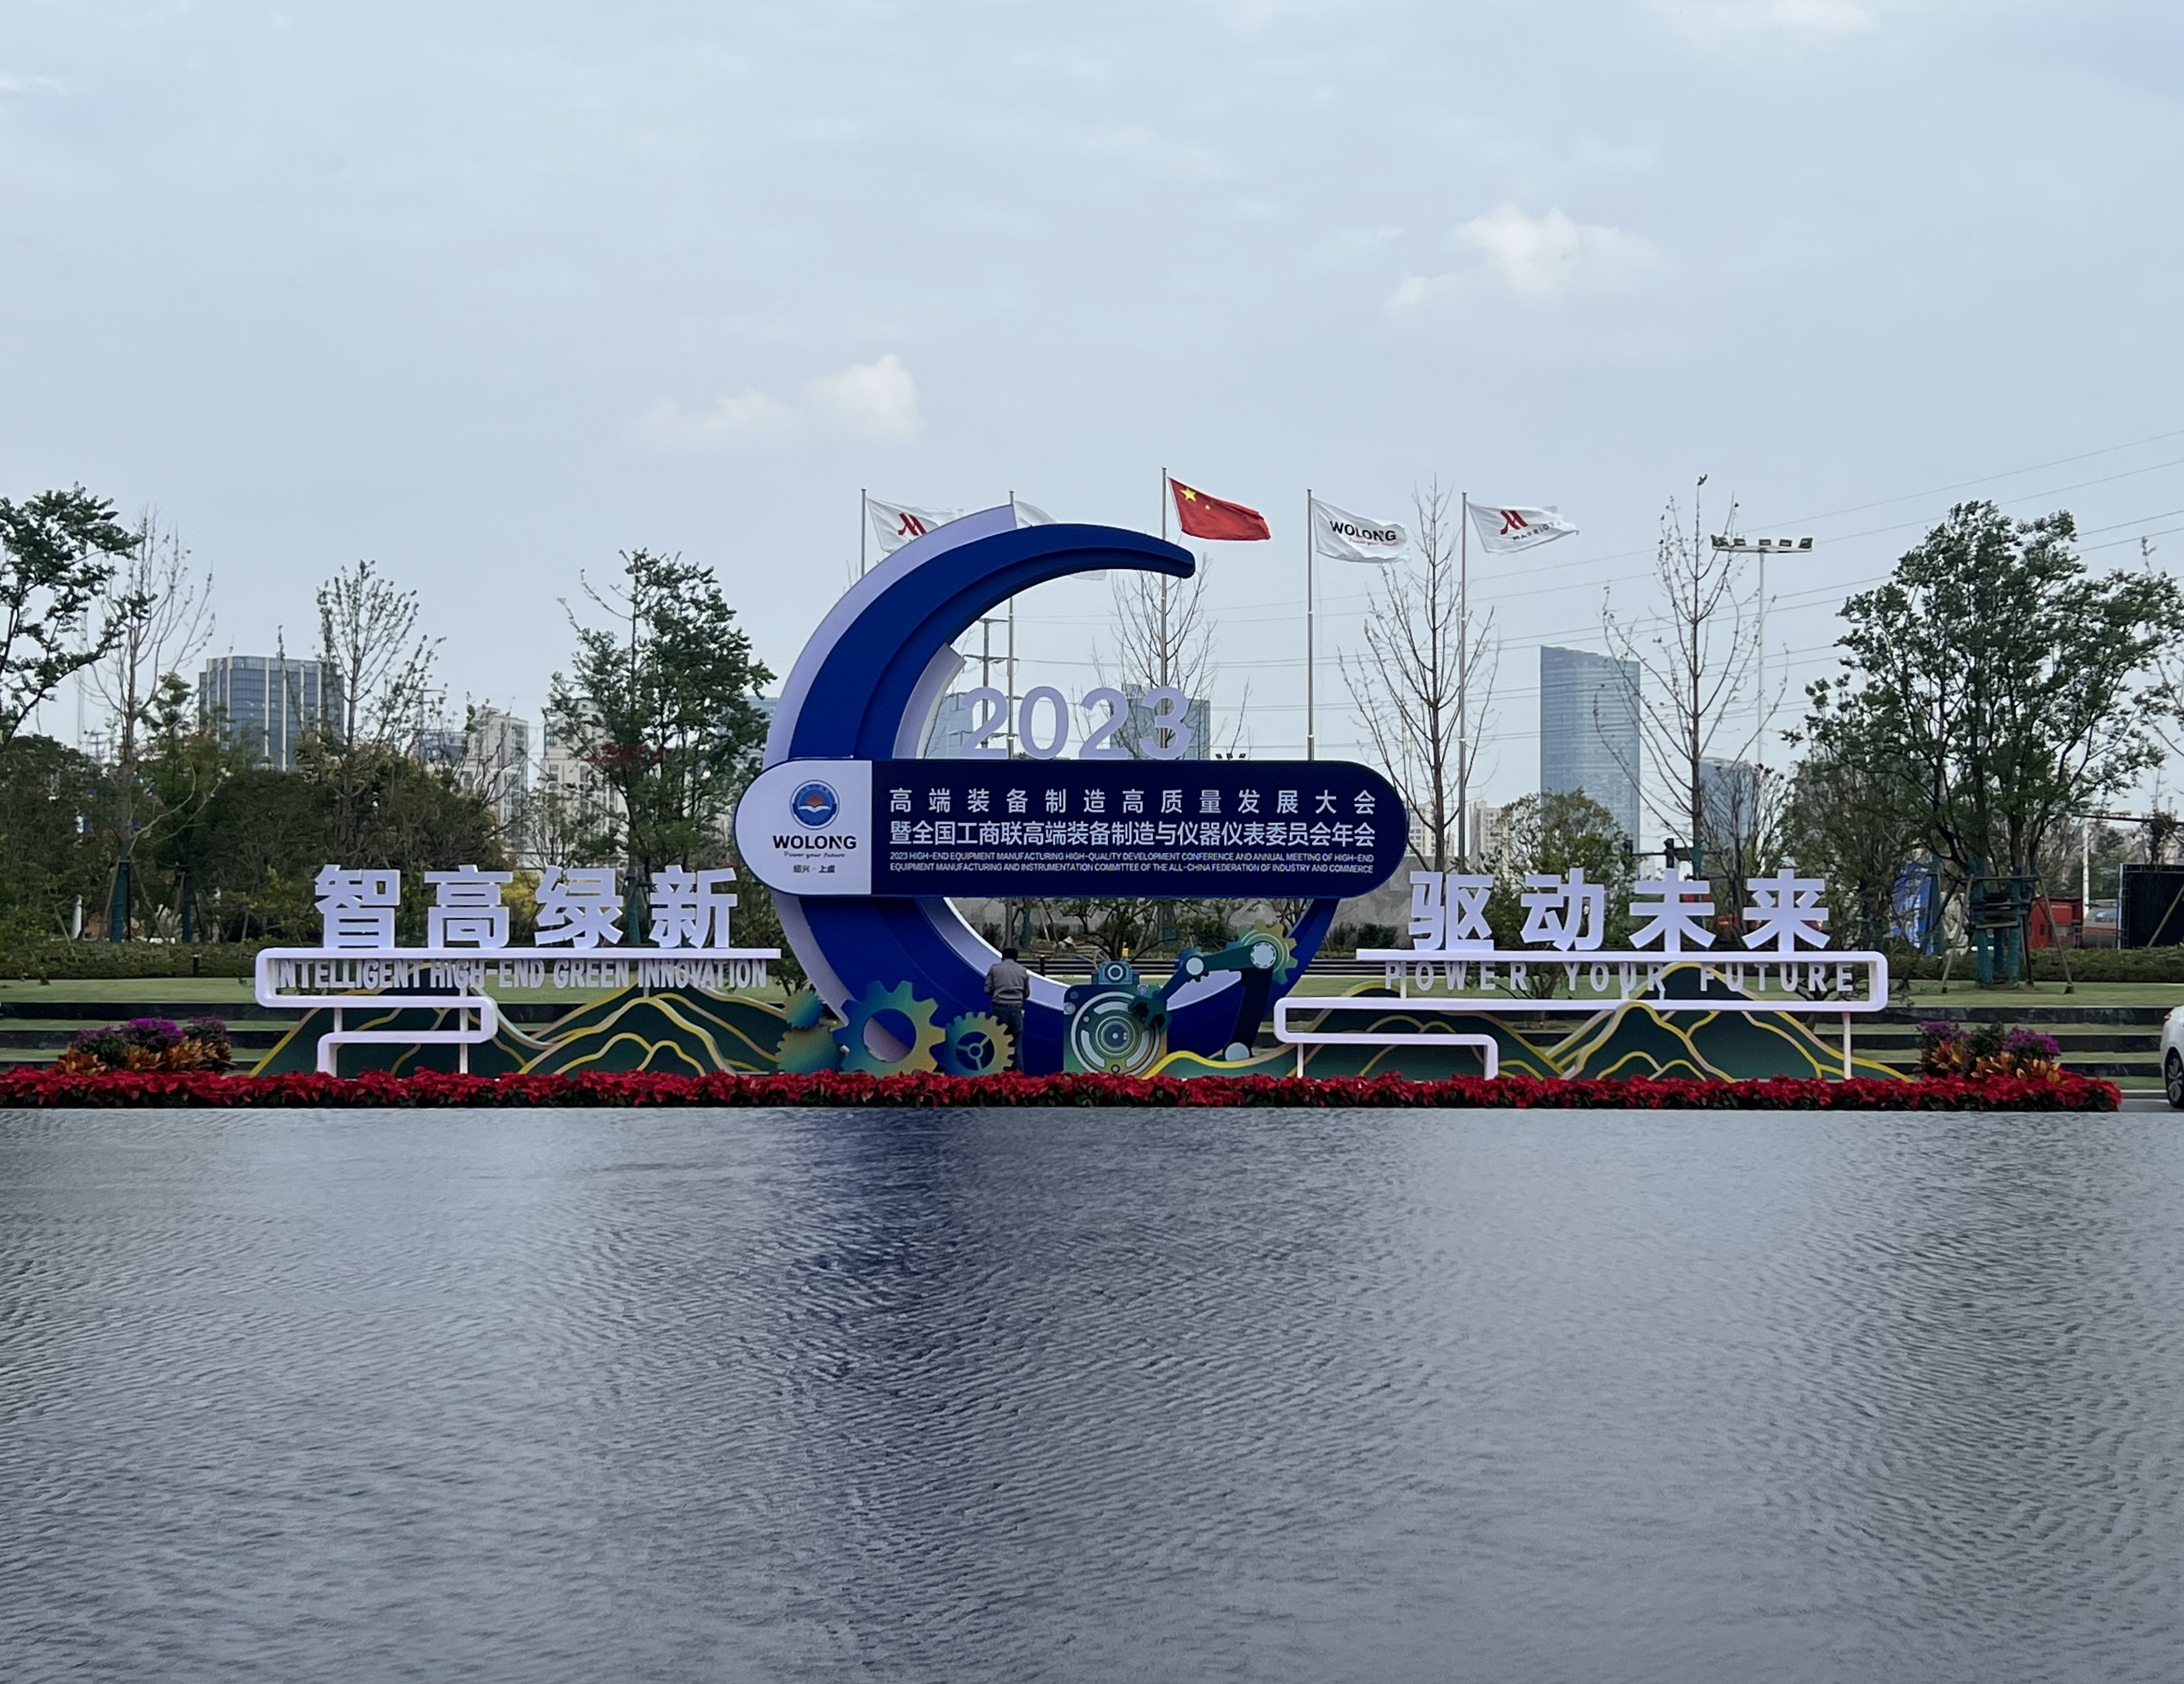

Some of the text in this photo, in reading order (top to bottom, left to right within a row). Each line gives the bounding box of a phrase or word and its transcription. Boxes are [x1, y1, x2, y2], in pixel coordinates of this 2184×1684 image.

[1329, 521, 1396, 542] WOLONG
[960, 686, 1191, 760] 2023
[890, 788, 1375, 814] 高端装备制造高质量发展大会
[773, 835, 857, 849] WOLONG
[890, 821, 1375, 847] 暨全国工商联高端装备制造与仪器仪表委员会年会
[891, 863, 934, 872] EQUIPMENT
[936, 863, 1002, 871] MANUFACTURING
[1212, 863, 1259, 872] FEDERATION
[1329, 865, 1373, 873] COMMERCE
[909, 852, 949, 860] HIGH-END
[950, 852, 995, 861] EQUIPMENT
[997, 852, 1063, 860] MANUFACTURING
[1066, 852, 1121, 861] HIGH-QUALITY
[1123, 852, 1180, 860] DEVELOPMENT
[1182, 852, 1233, 860] CONFERENCE
[1335, 854, 1373, 862] HIGH-END
[315, 864, 737, 948] 智高绿新
[1408, 868, 1830, 952] 驱动未来
[430, 959, 545, 989] HIGH-END
[553, 960, 629, 989] GREEN
[638, 960, 767, 989] INNOVATION
[1385, 962, 1853, 992] POWER YOUR FUTURE
